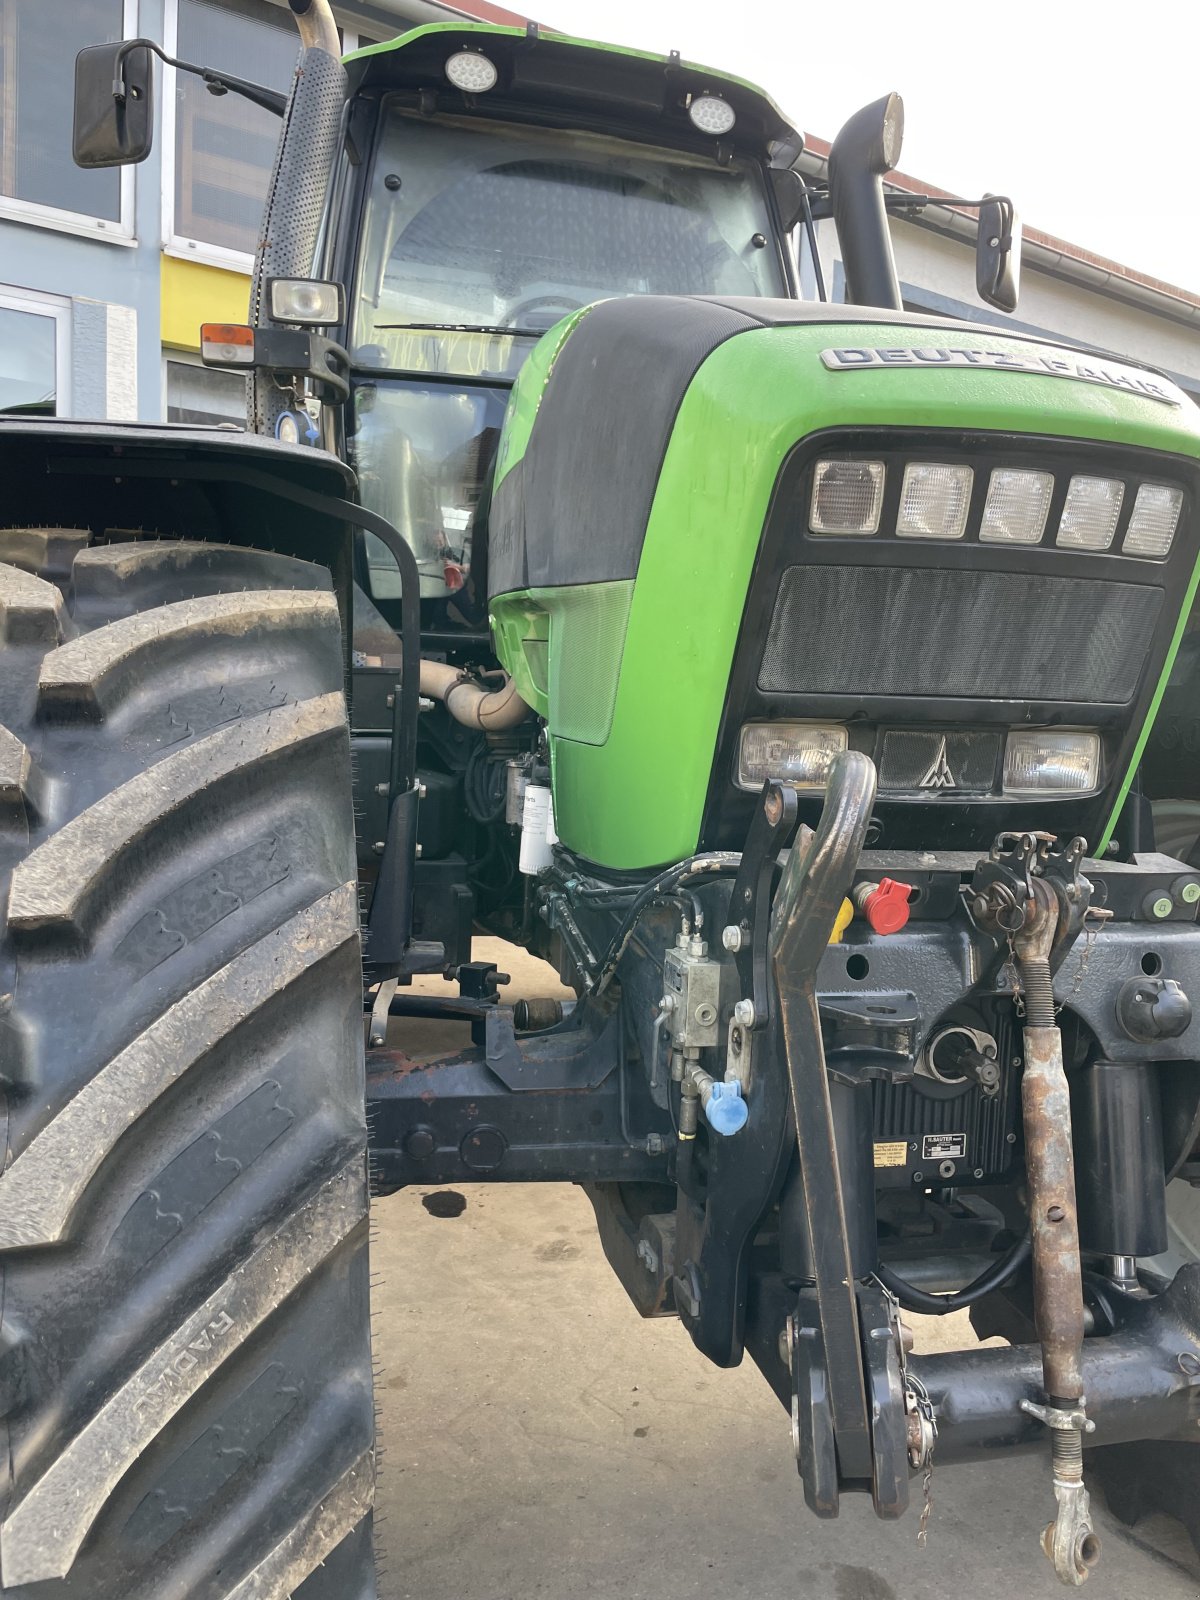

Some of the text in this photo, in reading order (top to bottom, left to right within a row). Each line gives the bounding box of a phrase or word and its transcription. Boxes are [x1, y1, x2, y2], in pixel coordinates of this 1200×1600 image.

[832, 348, 1173, 399] DEUTZ FAHR
[132, 1311, 235, 1425] RADIAL
